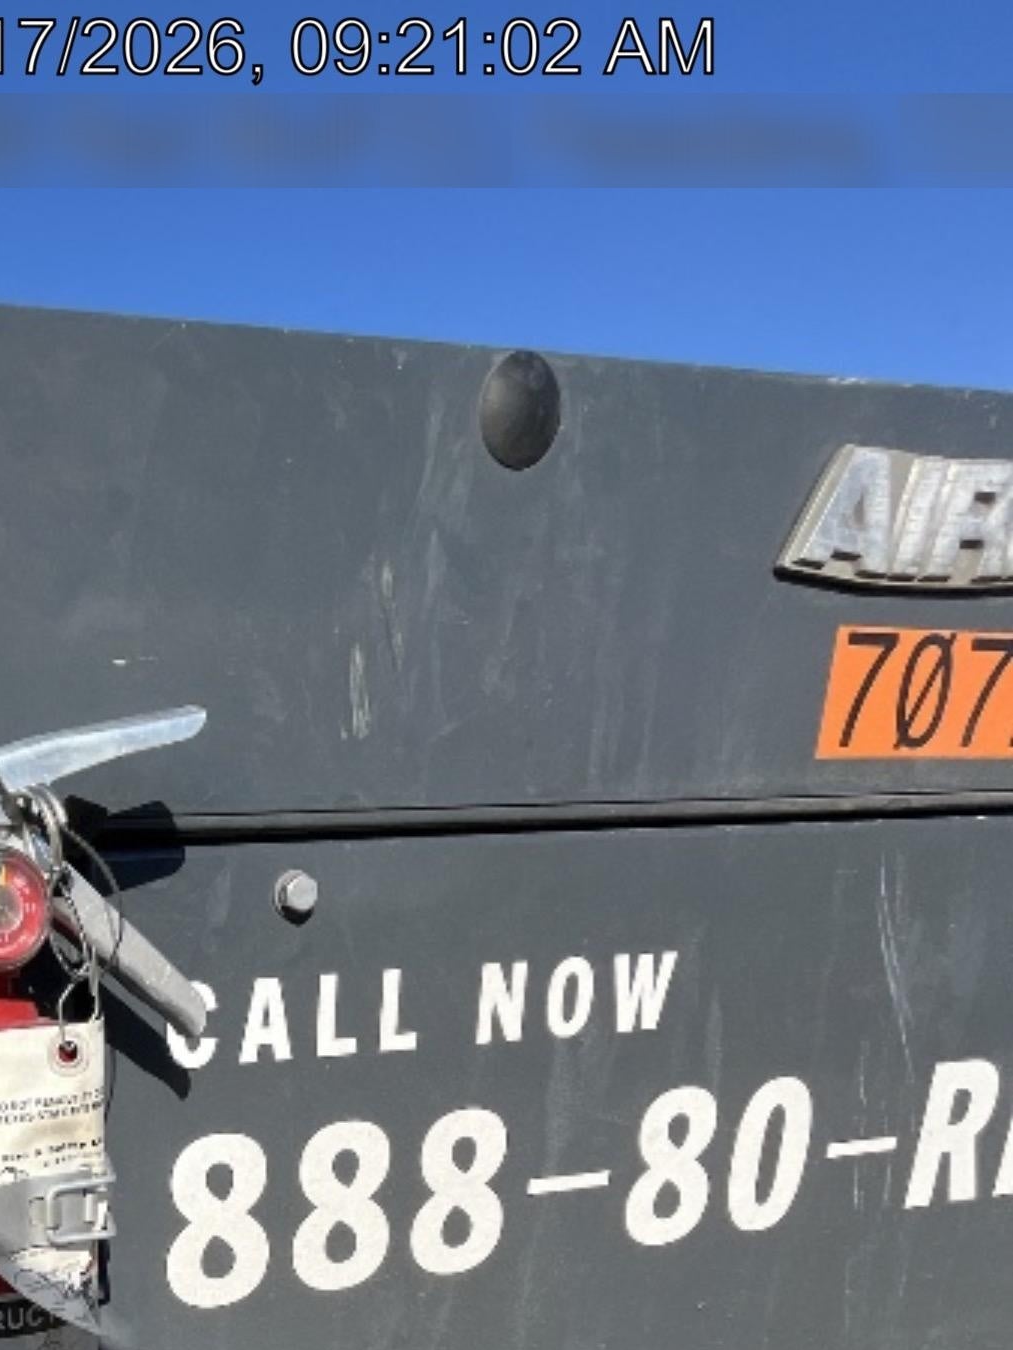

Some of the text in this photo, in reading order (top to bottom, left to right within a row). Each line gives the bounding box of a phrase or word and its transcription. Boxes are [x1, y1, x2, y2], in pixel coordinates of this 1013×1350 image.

[792, 446, 1013, 584] AIR
[839, 631, 1013, 750] 707
[166, 950, 679, 1070] CALL NOW
[165, 1057, 1013, 1309] 888-80-R
